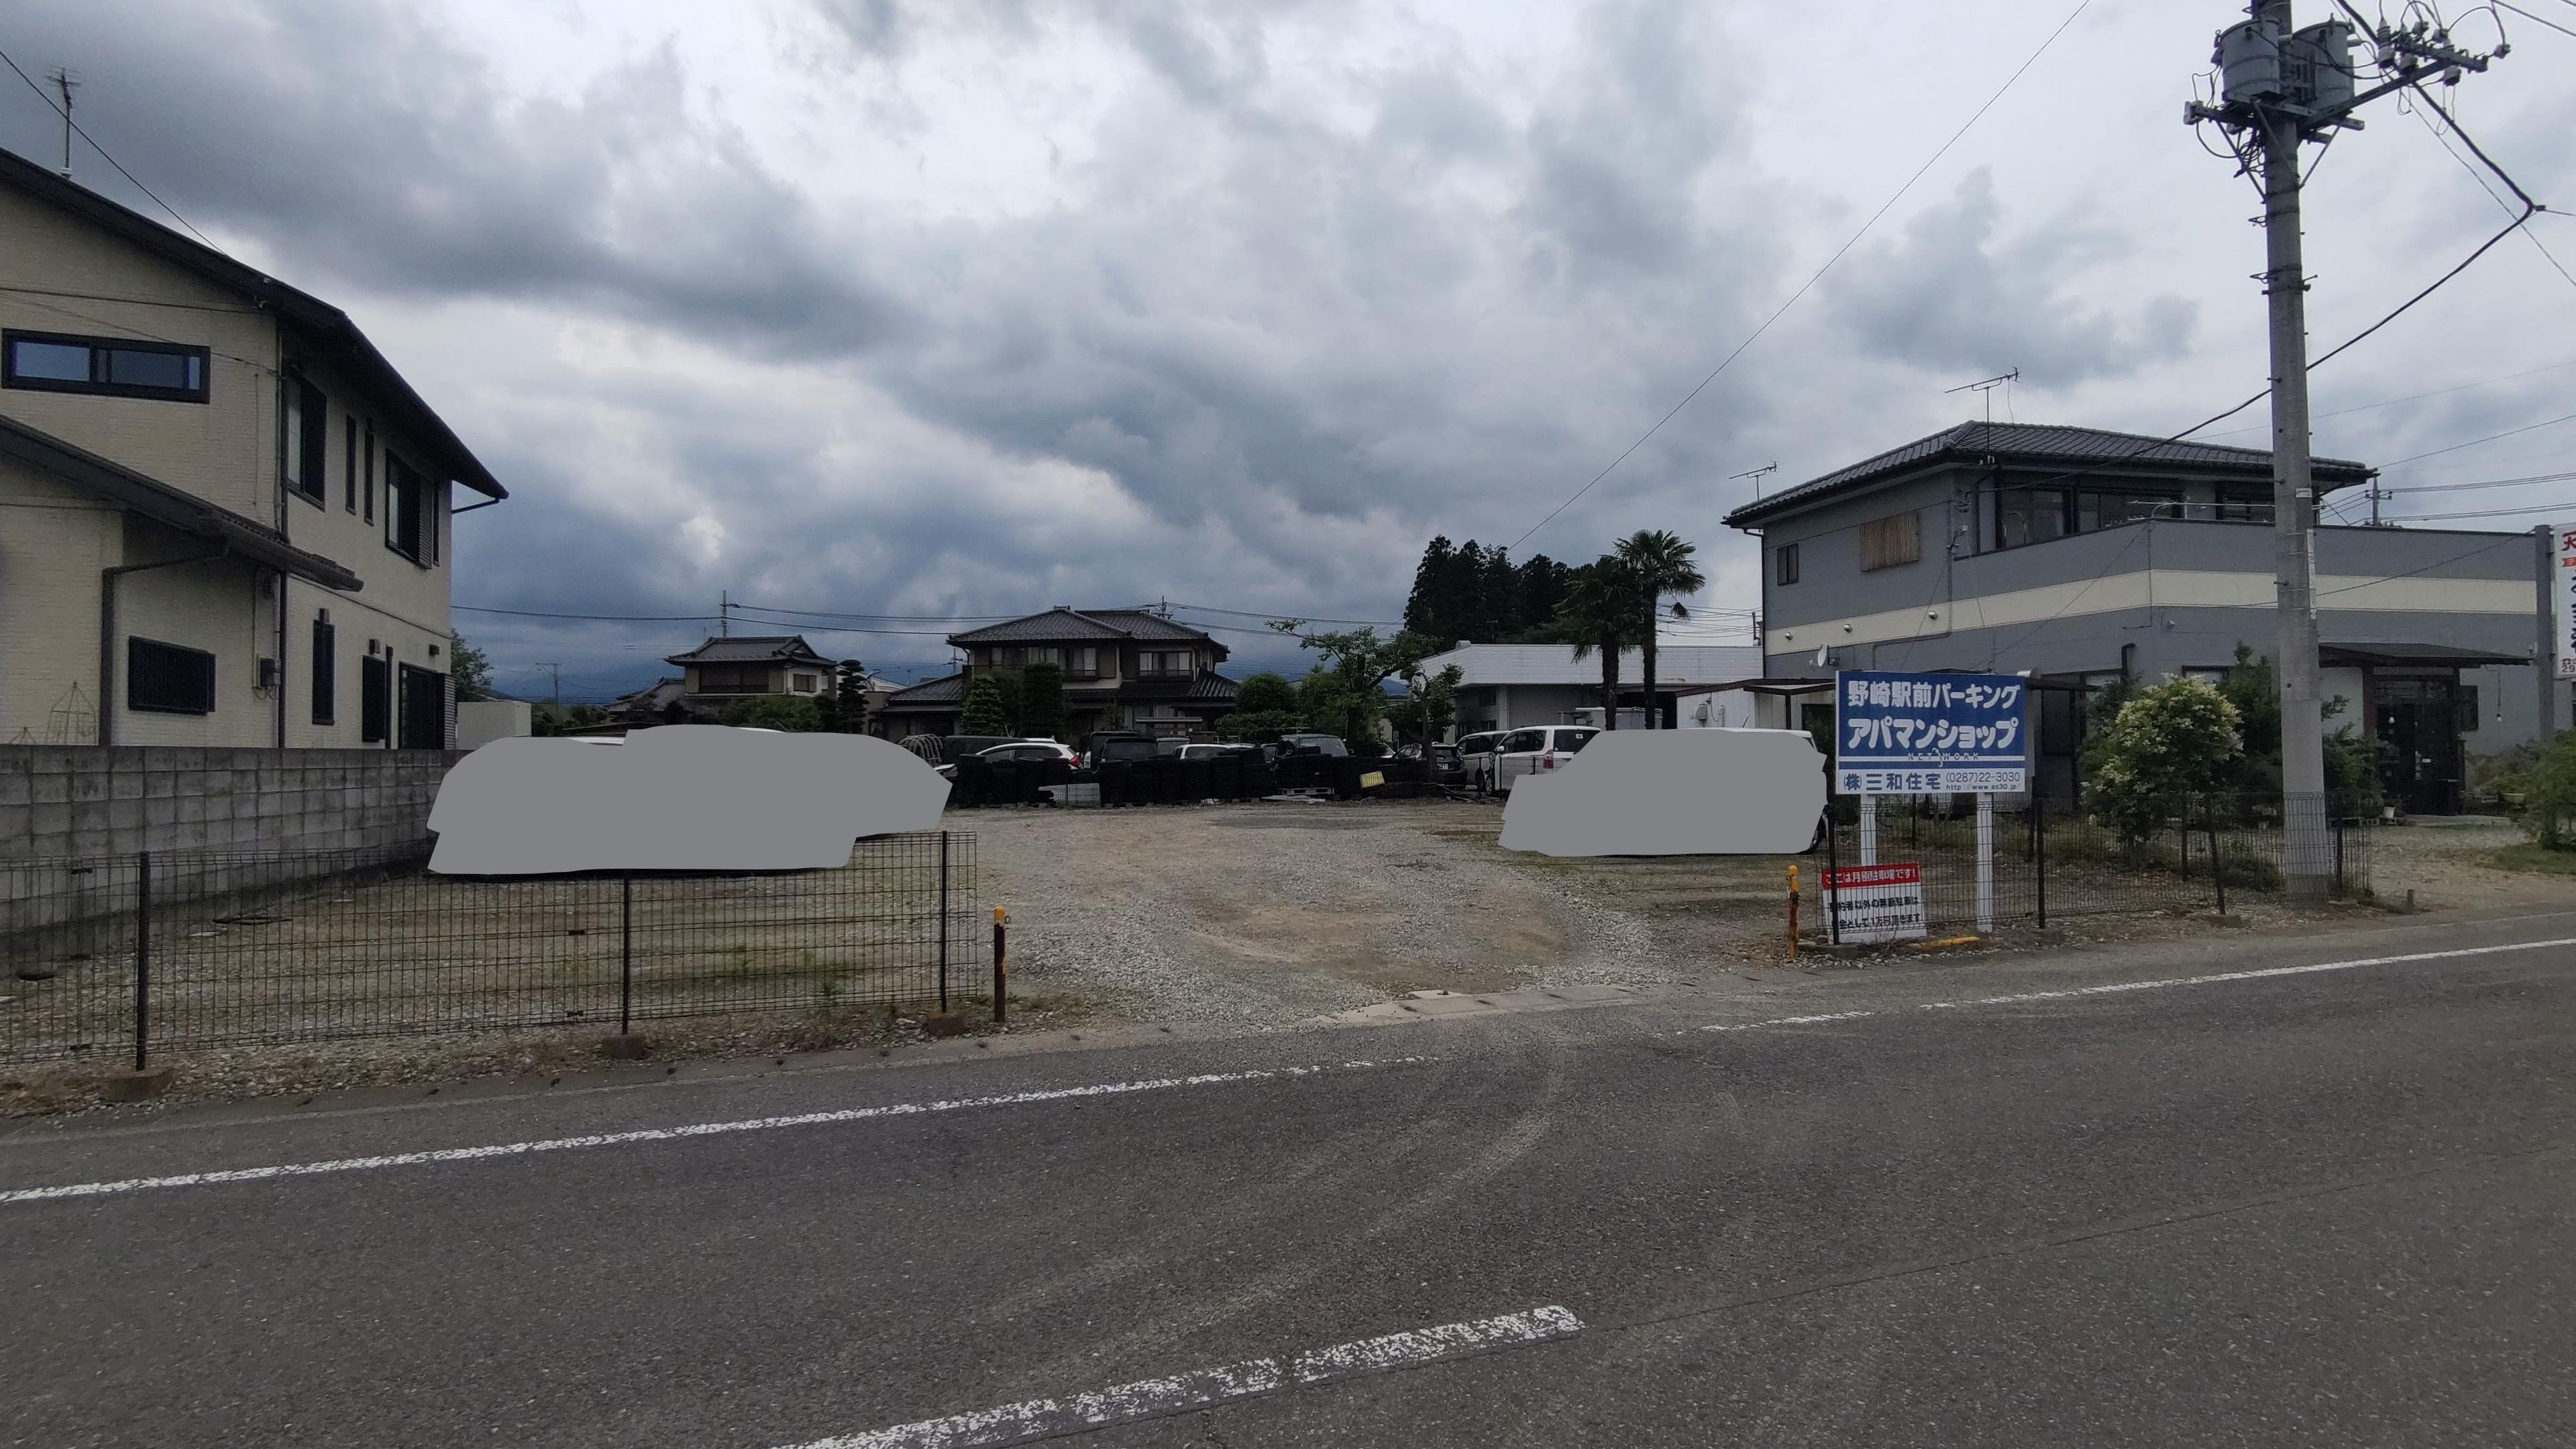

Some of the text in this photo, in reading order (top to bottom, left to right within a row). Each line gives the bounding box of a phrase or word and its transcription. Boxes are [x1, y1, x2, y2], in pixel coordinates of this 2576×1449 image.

[1848, 680, 2021, 708] 野崎駅前パーキング
[1848, 716, 2019, 749] アパマンショップ
[1946, 771, 2021, 783] (0287)22-3030
